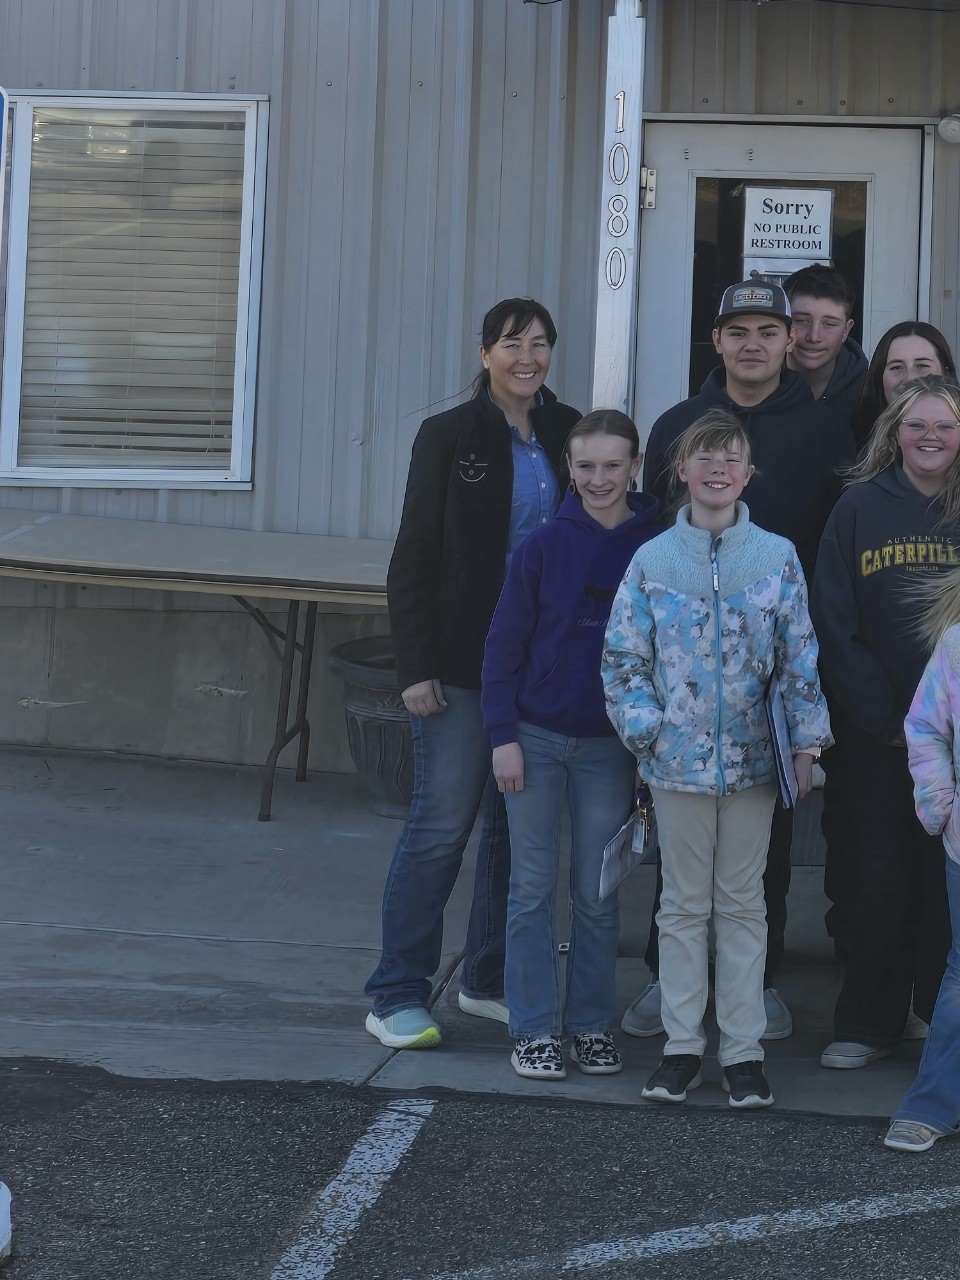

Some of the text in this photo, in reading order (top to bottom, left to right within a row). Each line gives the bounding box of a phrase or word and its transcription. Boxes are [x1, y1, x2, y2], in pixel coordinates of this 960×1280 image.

[605, 90, 630, 290] 1080
[762, 198, 814, 219] Sorry
[753, 223, 822, 234] NO PUBLIC
[751, 238, 822, 250] RESTROOM
